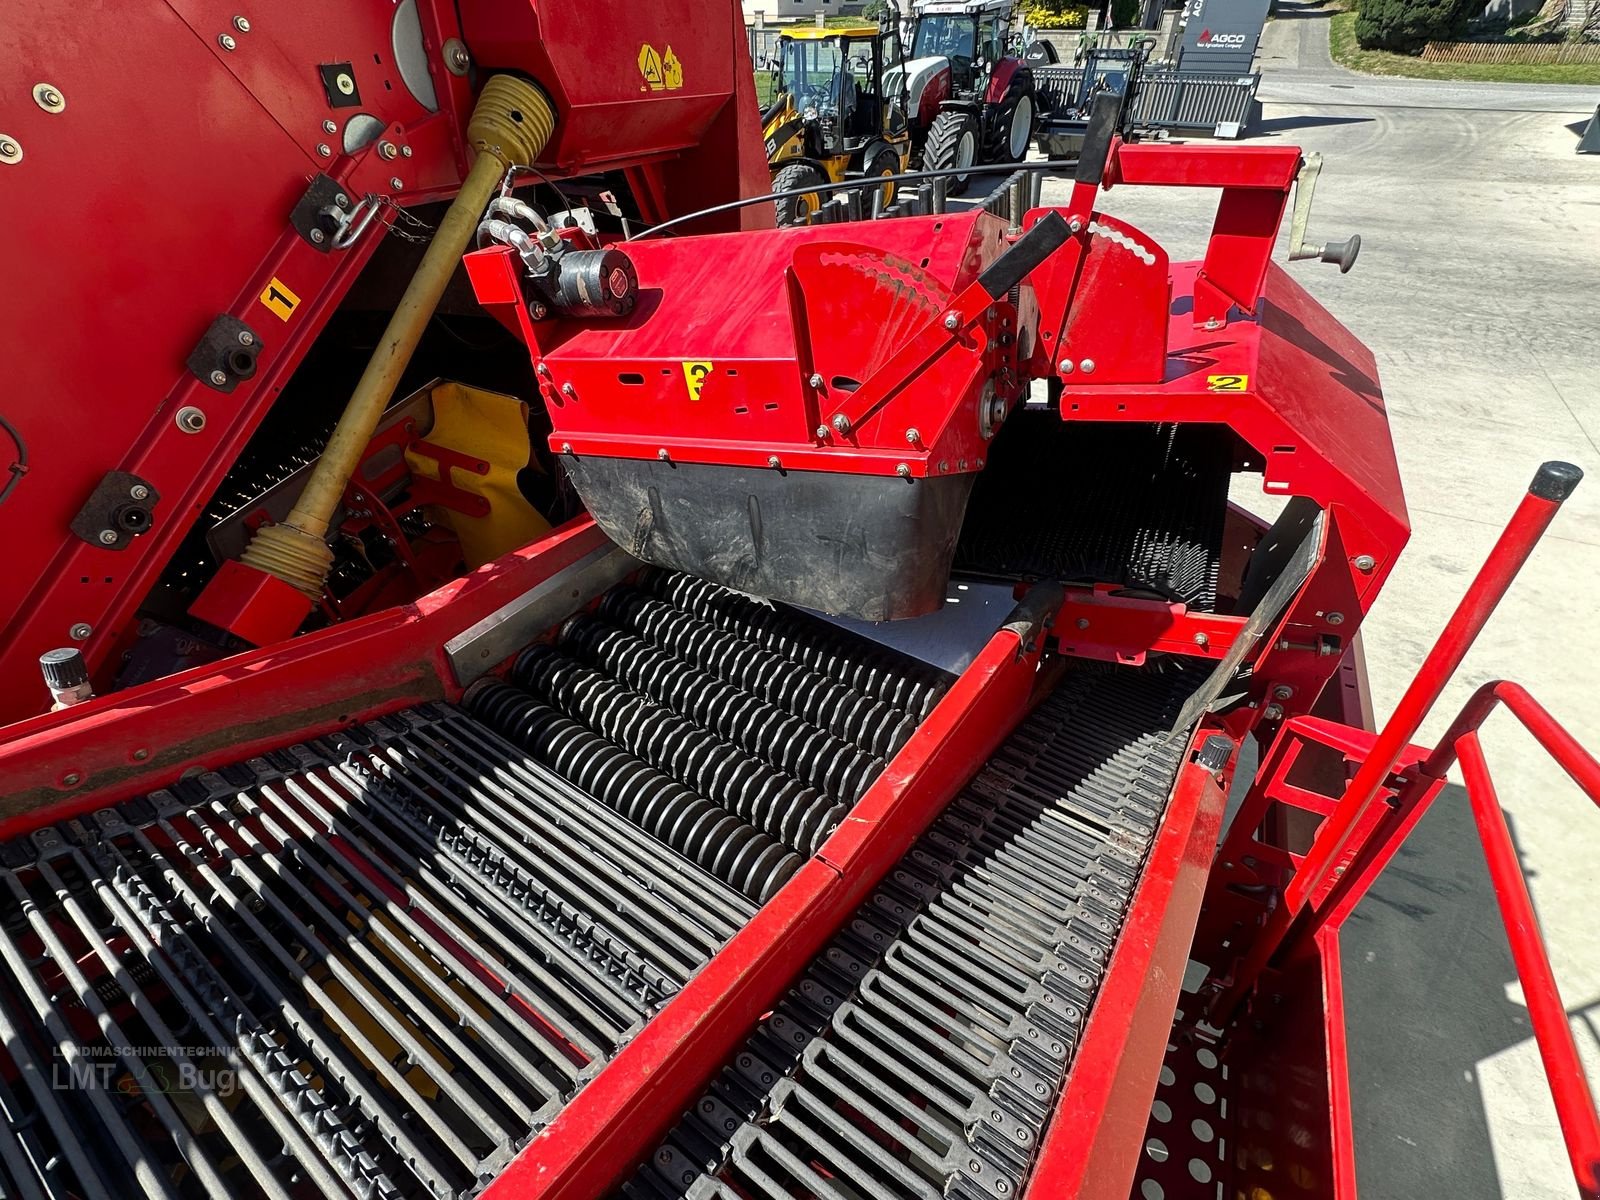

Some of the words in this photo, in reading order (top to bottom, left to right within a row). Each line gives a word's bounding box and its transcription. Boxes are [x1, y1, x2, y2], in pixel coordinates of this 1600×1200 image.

[1211, 34, 1245, 43] AGCO
[269, 286, 294, 309] 1
[1214, 376, 1242, 389] 2
